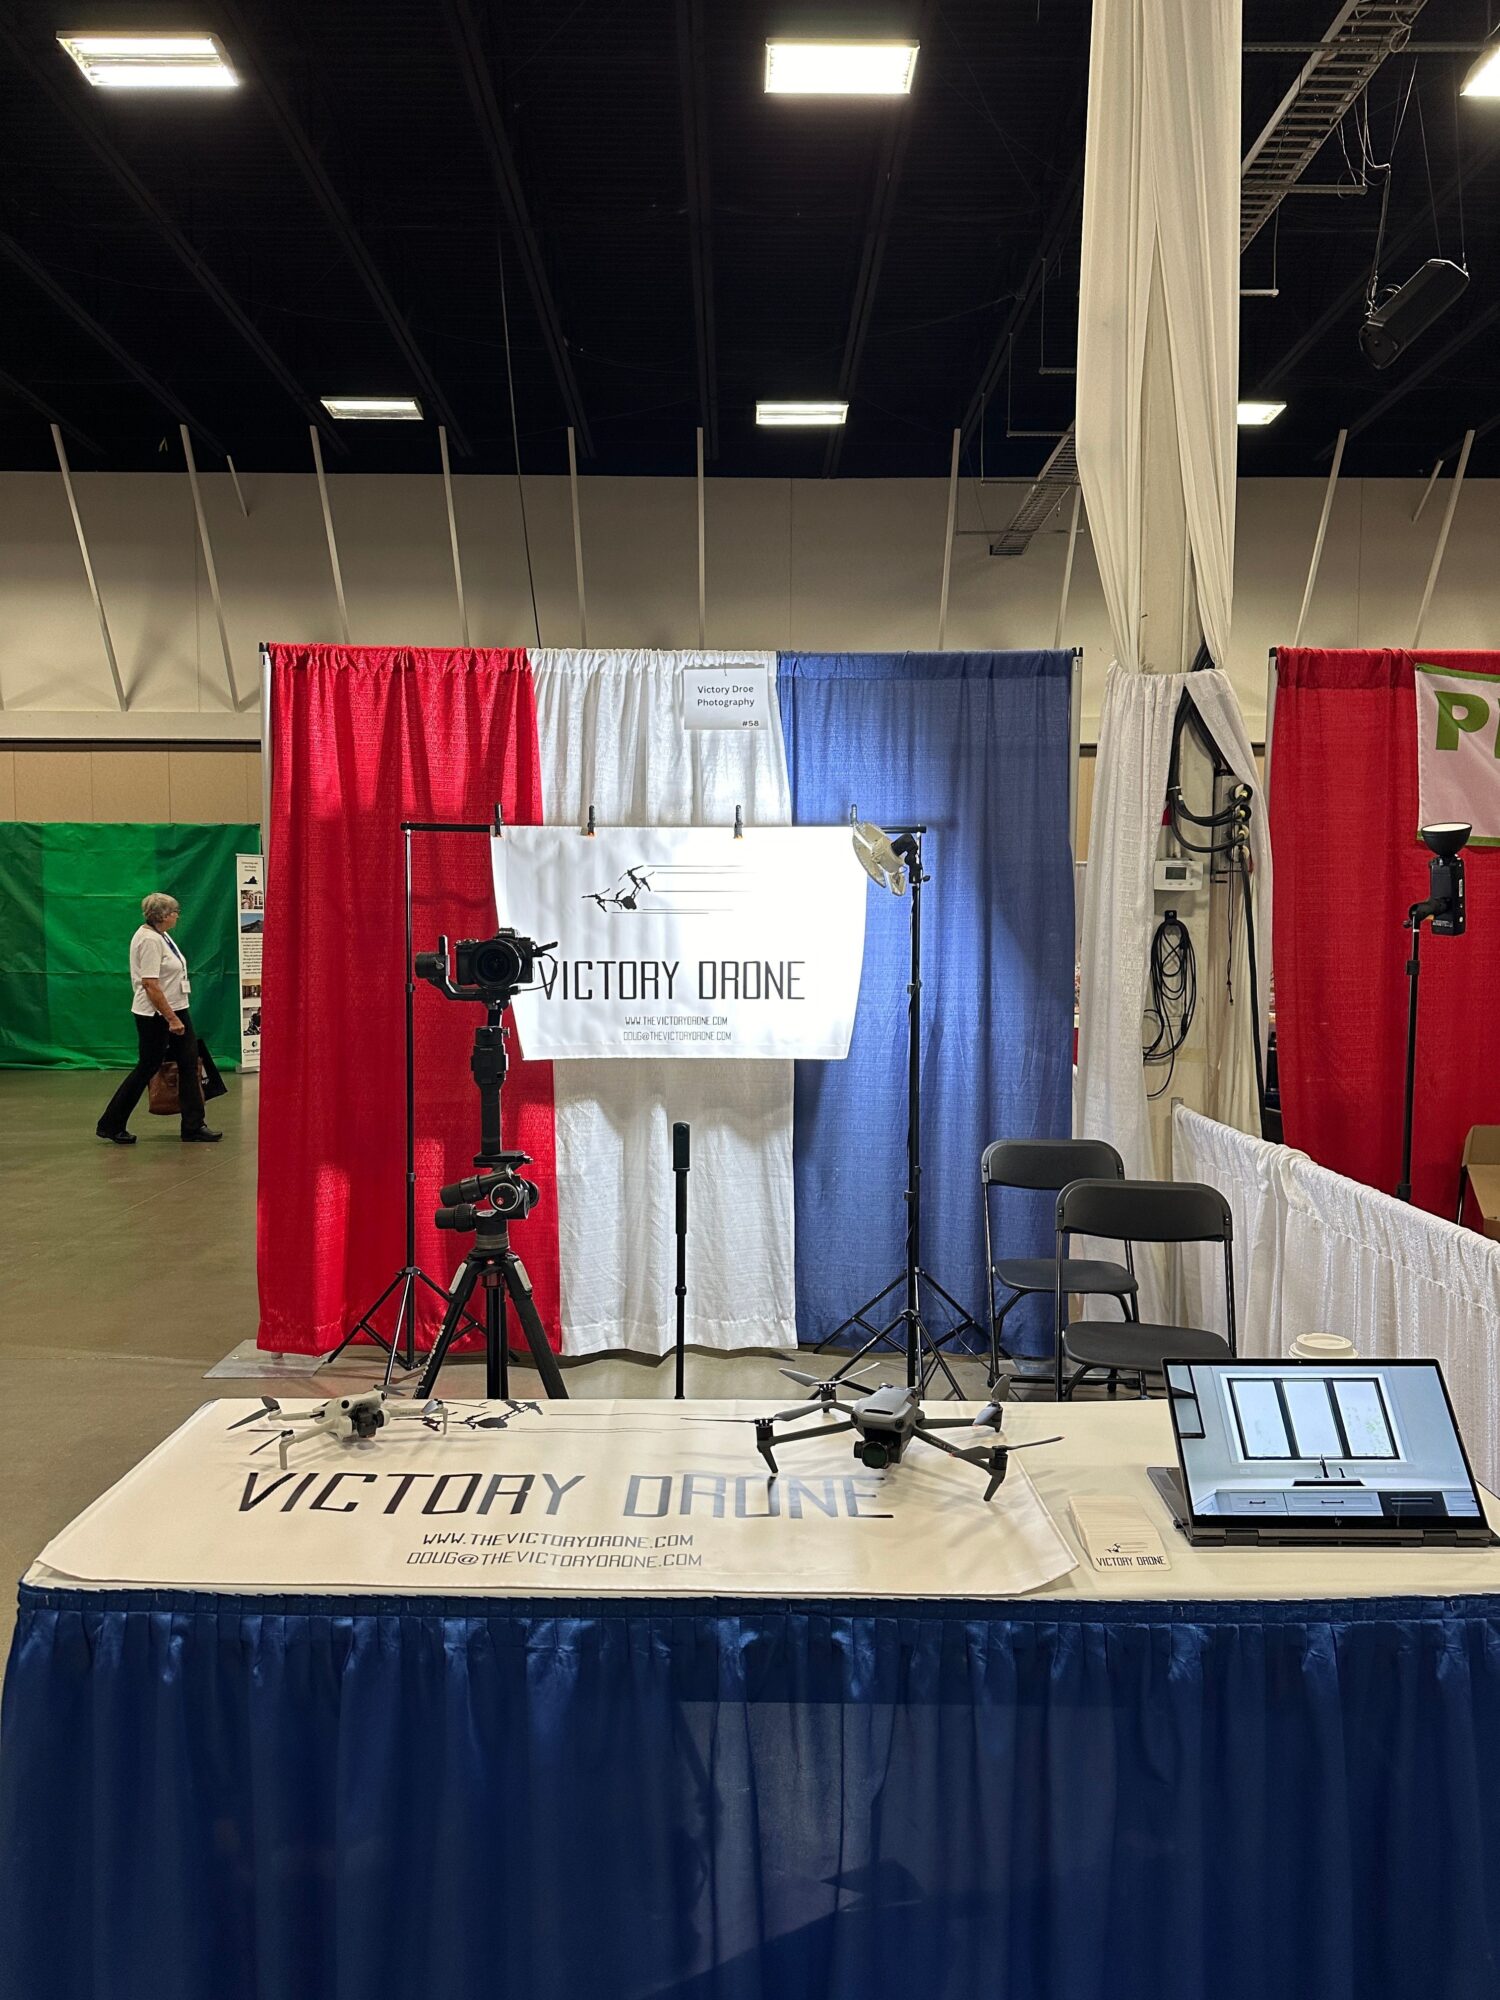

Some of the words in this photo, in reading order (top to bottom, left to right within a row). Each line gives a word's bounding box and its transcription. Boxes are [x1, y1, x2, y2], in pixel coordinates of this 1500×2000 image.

[697, 686, 730, 695] Victory
[732, 685, 754, 693] Droe
[697, 698, 755, 708] Photography
[1434, 690, 1500, 759] P
[537, 961, 680, 1000] VICTORY
[698, 961, 806, 1000] DRONE
[624, 1016, 728, 1026] WWW.THEVICTORYDRONE.COM
[623, 1031, 732, 1041] DOUG@THEVICTORYDRONE.COM
[238, 1472, 586, 1515] VICTORY
[623, 1474, 894, 1519] DRONE
[422, 1532, 694, 1549] WWW.THEVICTORYDRONE.COM
[406, 1551, 702, 1569] DOUG@THEVICTORYDRONE.COM
[1095, 1556, 1133, 1566] VICTORY
[1136, 1555, 1167, 1566] DRONE
